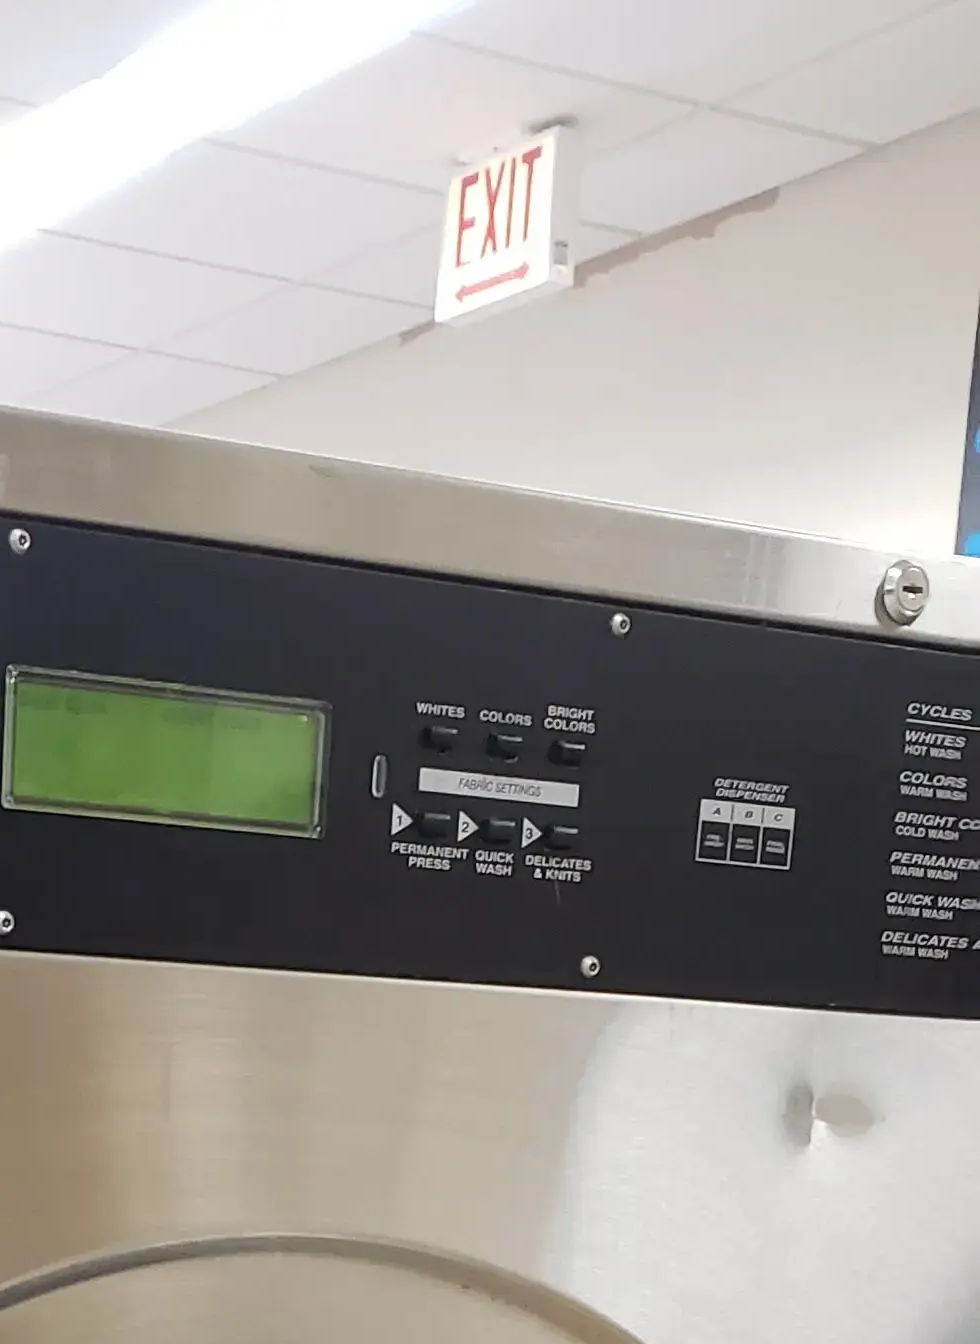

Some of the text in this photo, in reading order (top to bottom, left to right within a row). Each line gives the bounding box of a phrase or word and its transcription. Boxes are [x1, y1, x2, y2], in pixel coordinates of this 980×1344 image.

[455, 145, 543, 268] EXIT
[416, 702, 465, 718] WHITES
[479, 709, 532, 726] COLORS
[547, 705, 595, 721] BRIGHT
[907, 702, 973, 721] CYCLES
[544, 719, 595, 734] COLORS
[905, 730, 967, 748] WHITES
[904, 744, 961, 759] HOT WASH
[714, 778, 789, 793] DETERGENT
[900, 771, 968, 788] COLORS
[459, 777, 542, 798] FABRIC SETTINGS
[716, 788, 785, 803] DISPENSER
[713, 807, 721, 815] A
[396, 815, 402, 827] 1
[894, 811, 957, 828] BRIGHT
[461, 822, 469, 833] 2
[525, 828, 533, 840] 3
[896, 825, 959, 840] COLD WASH
[391, 842, 469, 860] PERMANENT
[475, 850, 514, 864] QUICK
[408, 857, 451, 871] PRESS
[476, 863, 512, 876] WASH
[525, 855, 592, 871] DELICATES
[534, 868, 581, 882] & KNITS
[886, 892, 934, 906] QUICK
[881, 931, 969, 949] DELICATES
